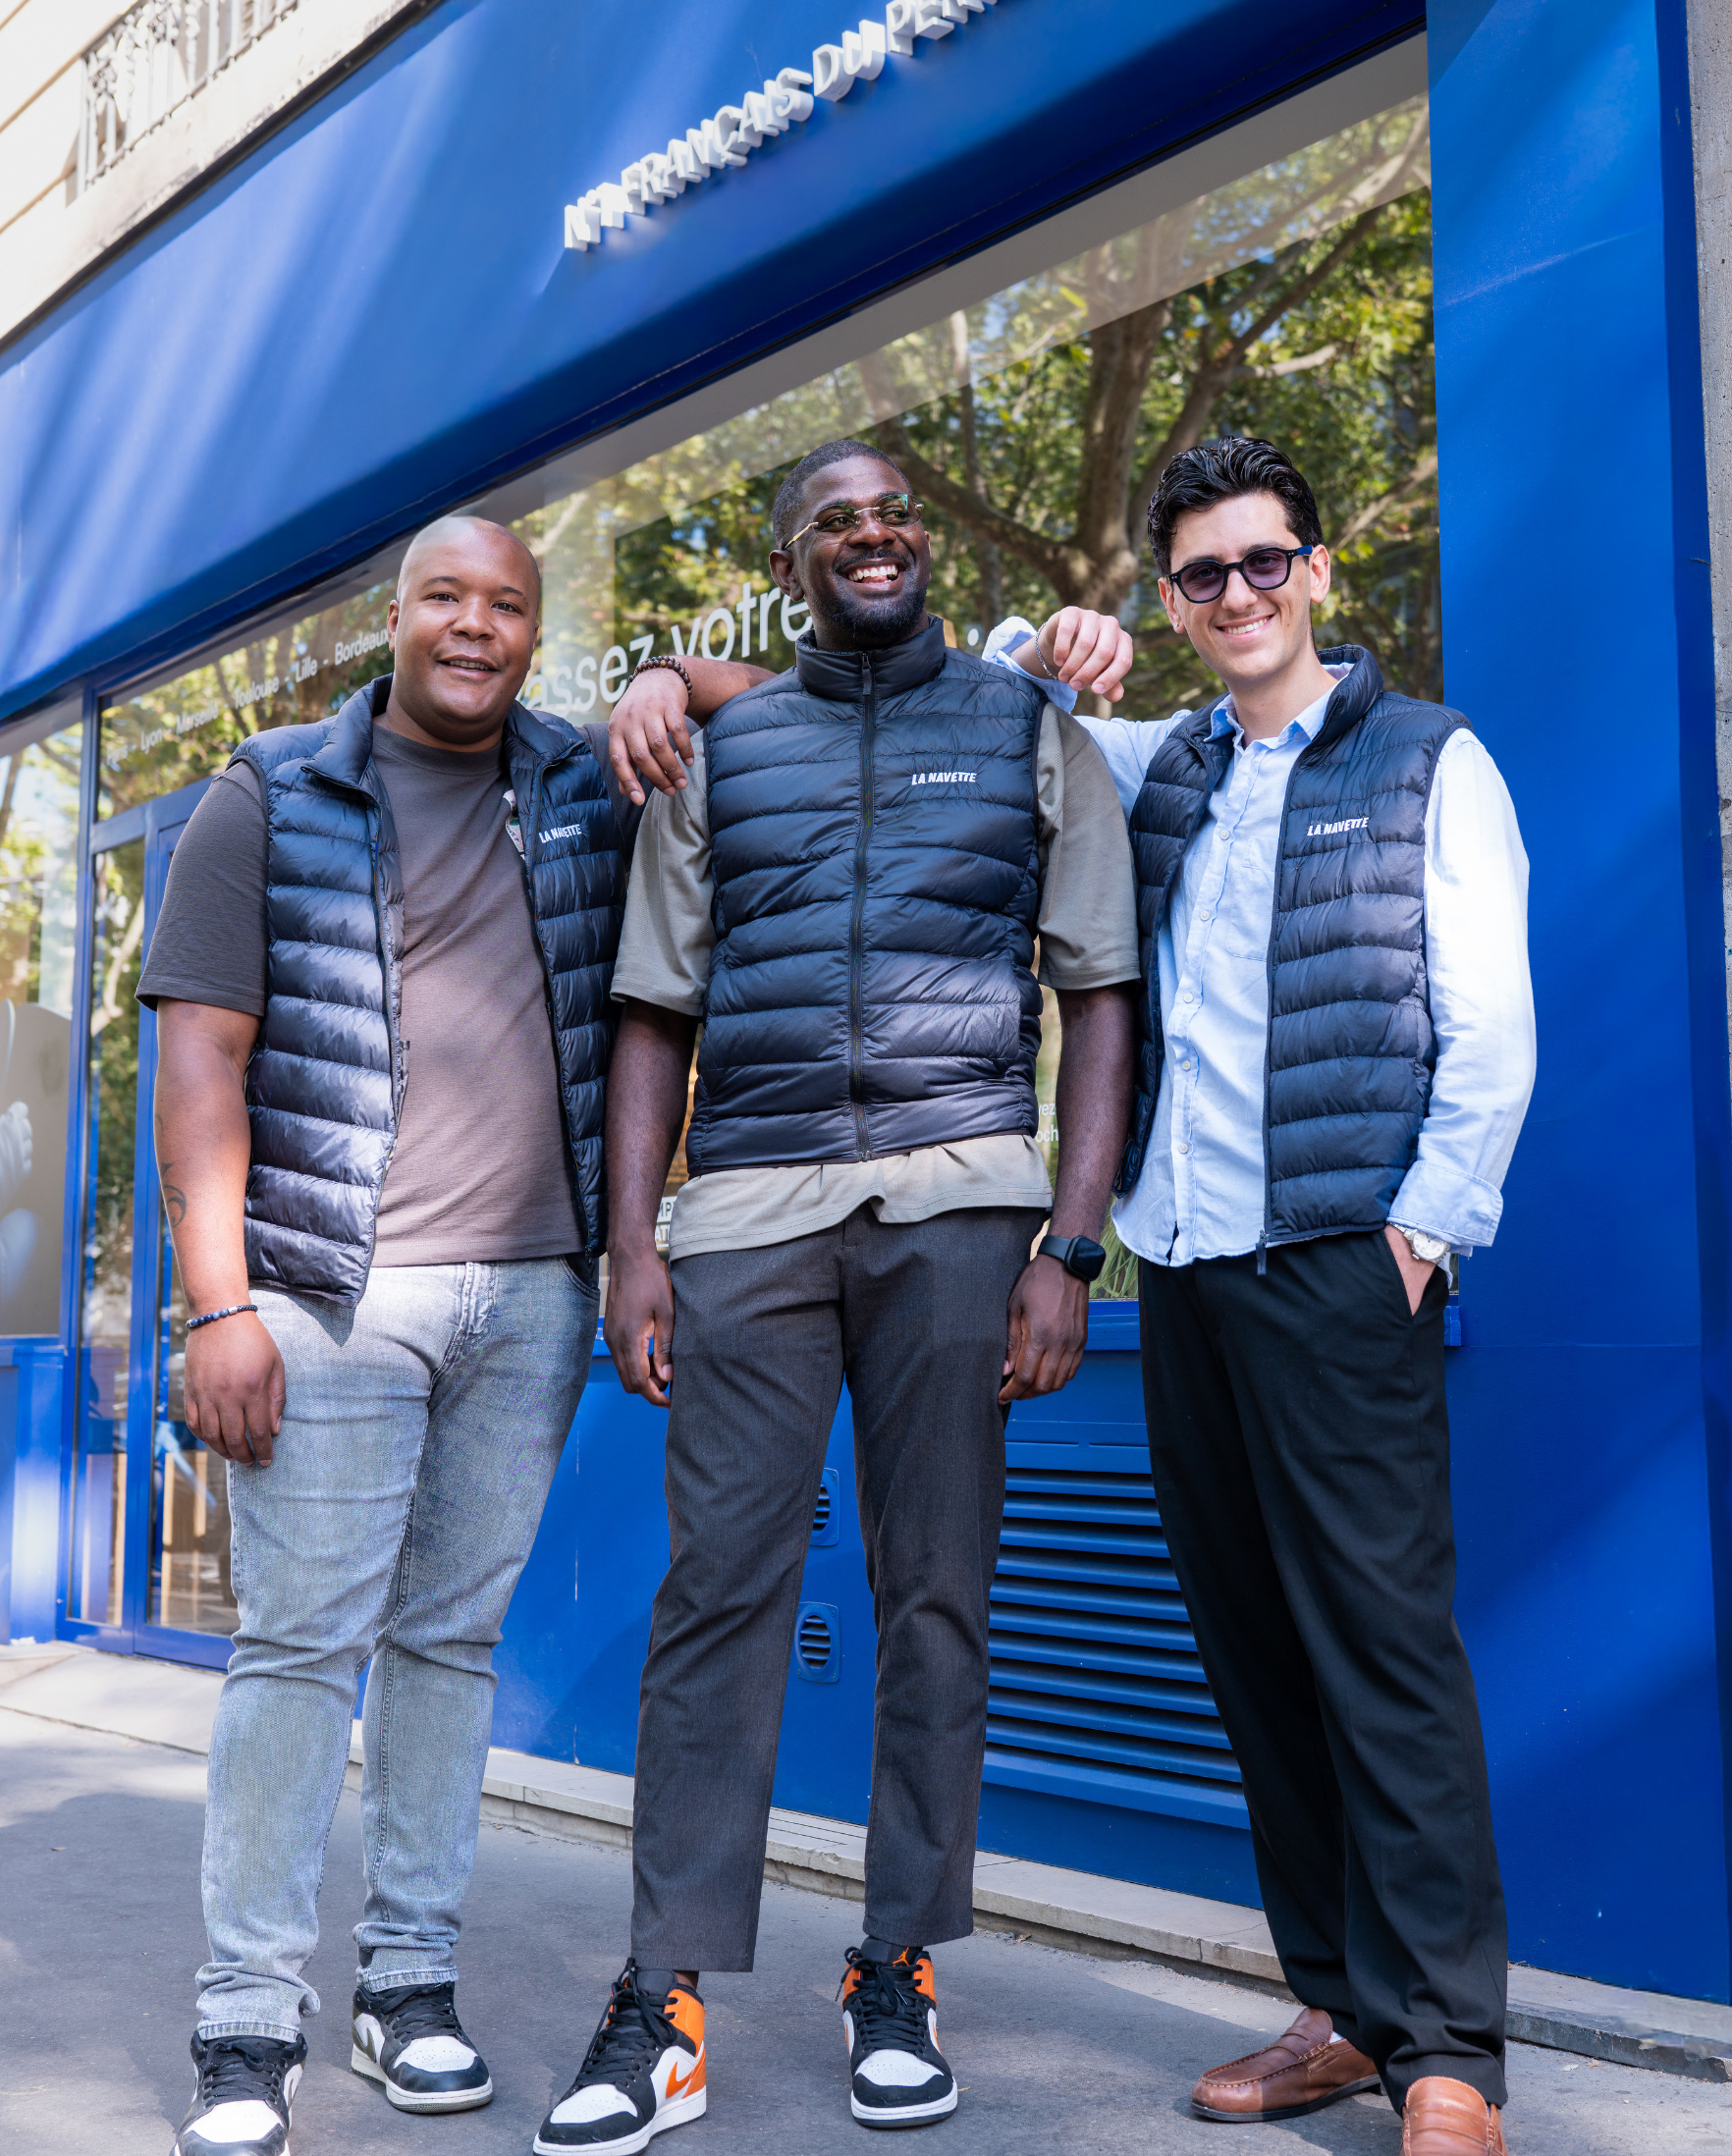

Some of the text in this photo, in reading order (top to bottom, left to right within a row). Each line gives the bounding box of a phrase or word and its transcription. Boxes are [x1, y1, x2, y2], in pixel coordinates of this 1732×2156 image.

[812, 20, 886, 102] DU
[886, 0, 999, 57] PE
[515, 581, 813, 719] assez votre
[140, 728, 163, 755] Lyon
[176, 700, 219, 735] Marseille
[234, 675, 280, 710] Toulouse
[296, 655, 318, 683] Lille
[335, 627, 390, 666] Bordeaux
[911, 772, 977, 786] LA NAVETTE
[538, 830, 551, 843] LA
[1307, 817, 1370, 836] LA NAVETTE
